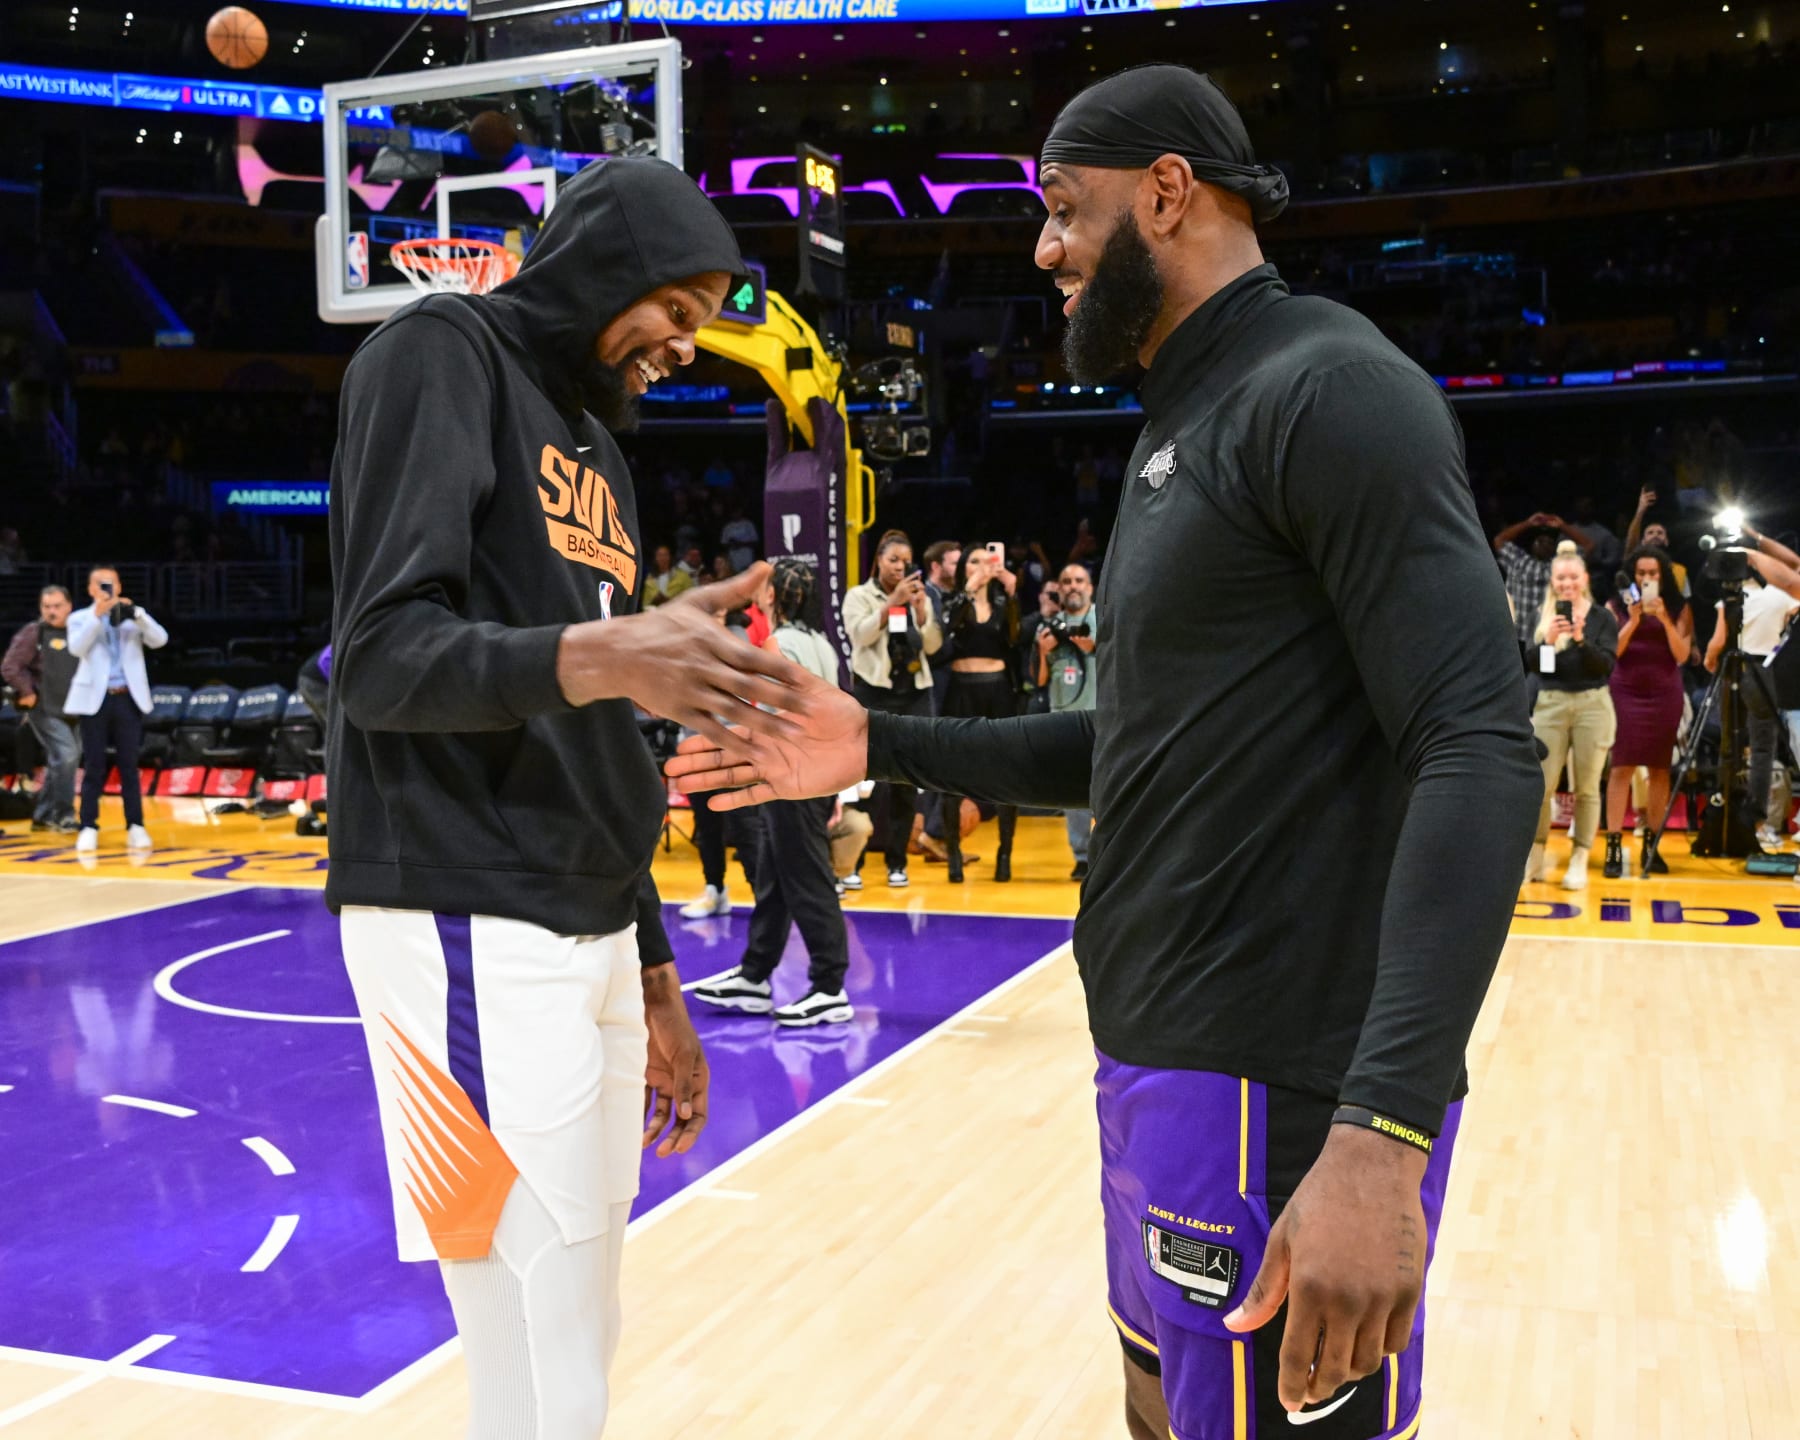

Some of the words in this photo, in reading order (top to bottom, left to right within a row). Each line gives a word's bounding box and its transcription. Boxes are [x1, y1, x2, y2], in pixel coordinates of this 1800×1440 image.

[628, 0, 764, 21] WORLD-CLASS
[768, 0, 844, 20] HEALTH
[846, 0, 898, 18] CARE
[193, 90, 251, 108] ULTRA
[228, 490, 322, 505] AMERICAN
[537, 444, 635, 556] SUNS
[1371, 1116, 1430, 1149] PROMISE
[1148, 1204, 1176, 1222] LEAVE
[1176, 1215, 1184, 1225] A
[1185, 1217, 1236, 1235] LEGACY
